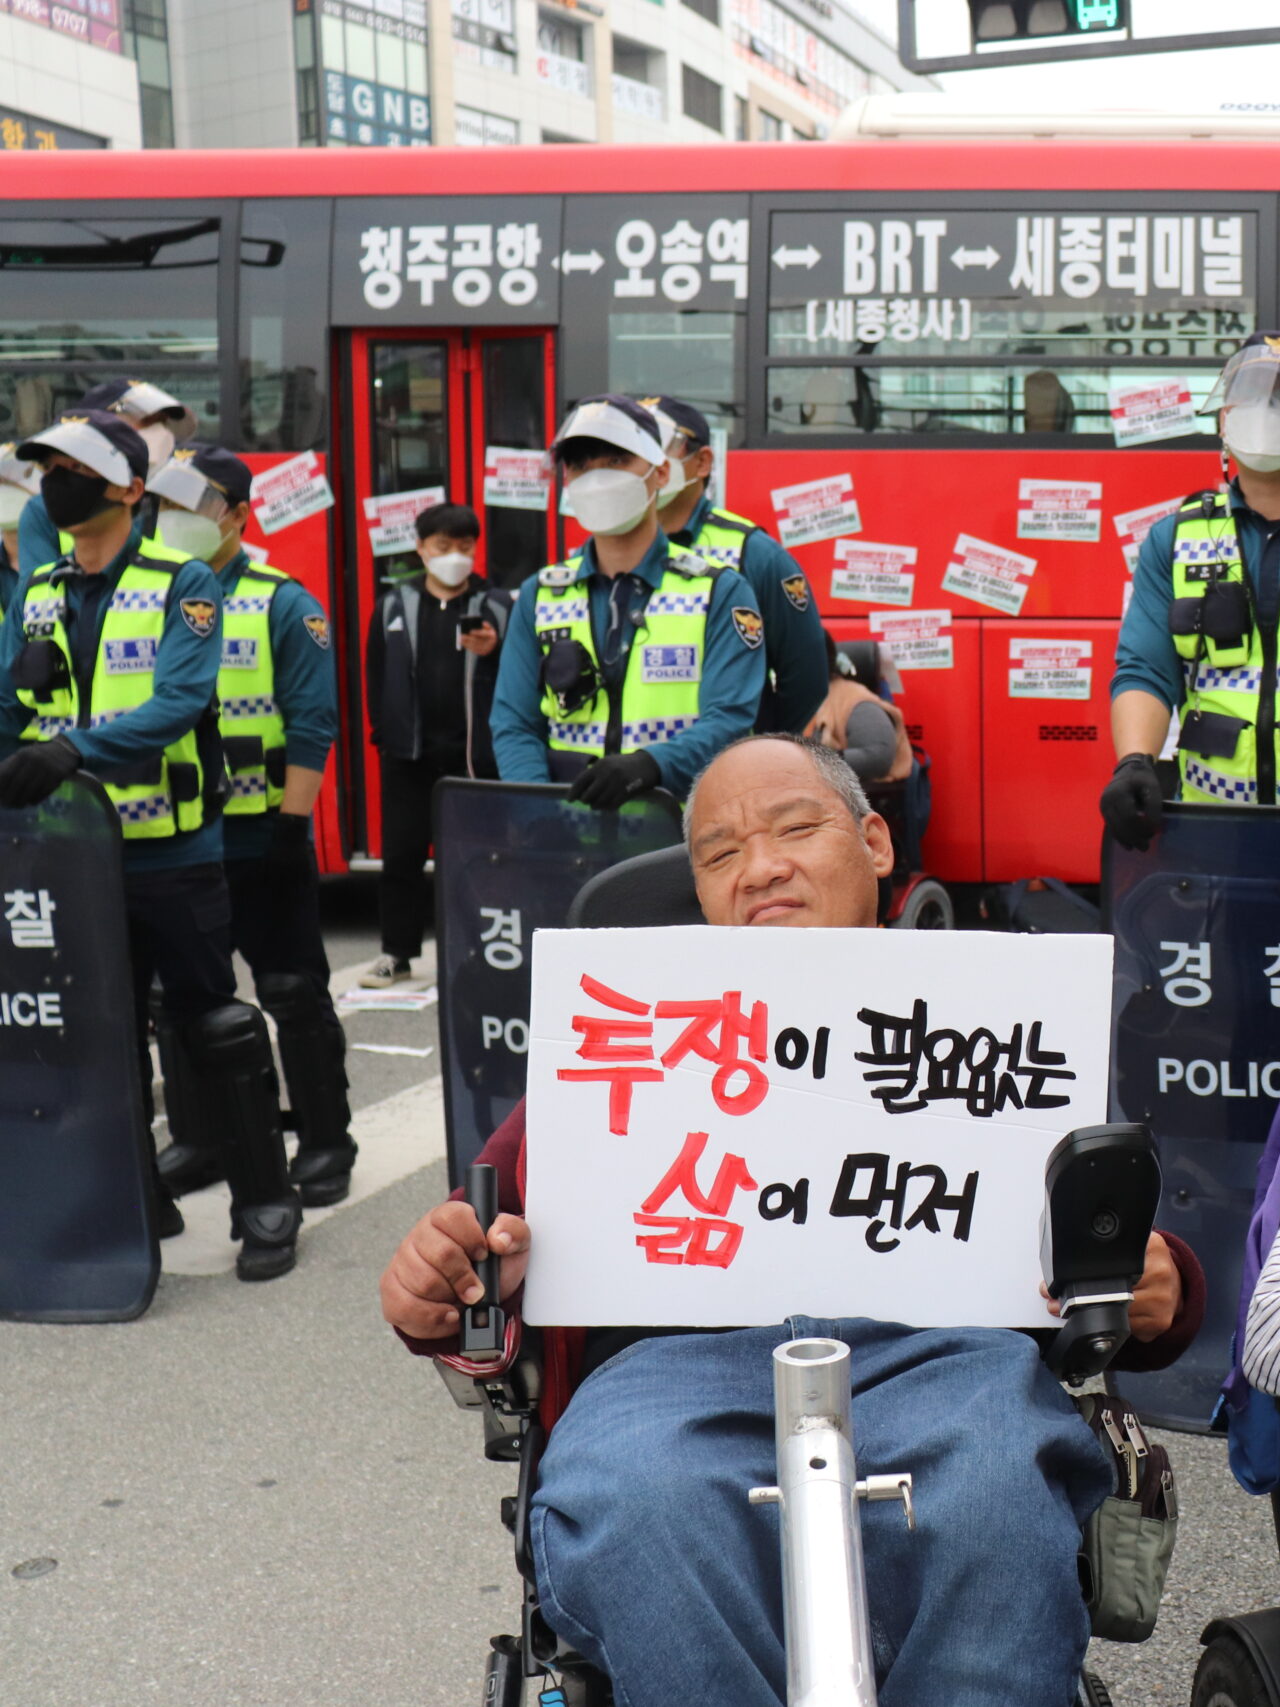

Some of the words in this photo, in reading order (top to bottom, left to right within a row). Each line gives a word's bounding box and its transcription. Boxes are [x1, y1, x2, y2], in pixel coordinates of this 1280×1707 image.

[352, 83, 430, 131] GNB
[359, 223, 542, 310] 청주공항
[614, 219, 749, 302] 오송역
[843, 219, 947, 295] BRT
[1009, 216, 1243, 299] 세종터미널
[647, 668, 693, 678] POLICE
[4, 889, 57, 948] 찰
[480, 907, 524, 970] 경
[557, 973, 830, 1136] 투쟁이
[854, 998, 1077, 1117] 필요없는
[633, 1132, 810, 1269] 삶이
[828, 1152, 980, 1253] 먼저
